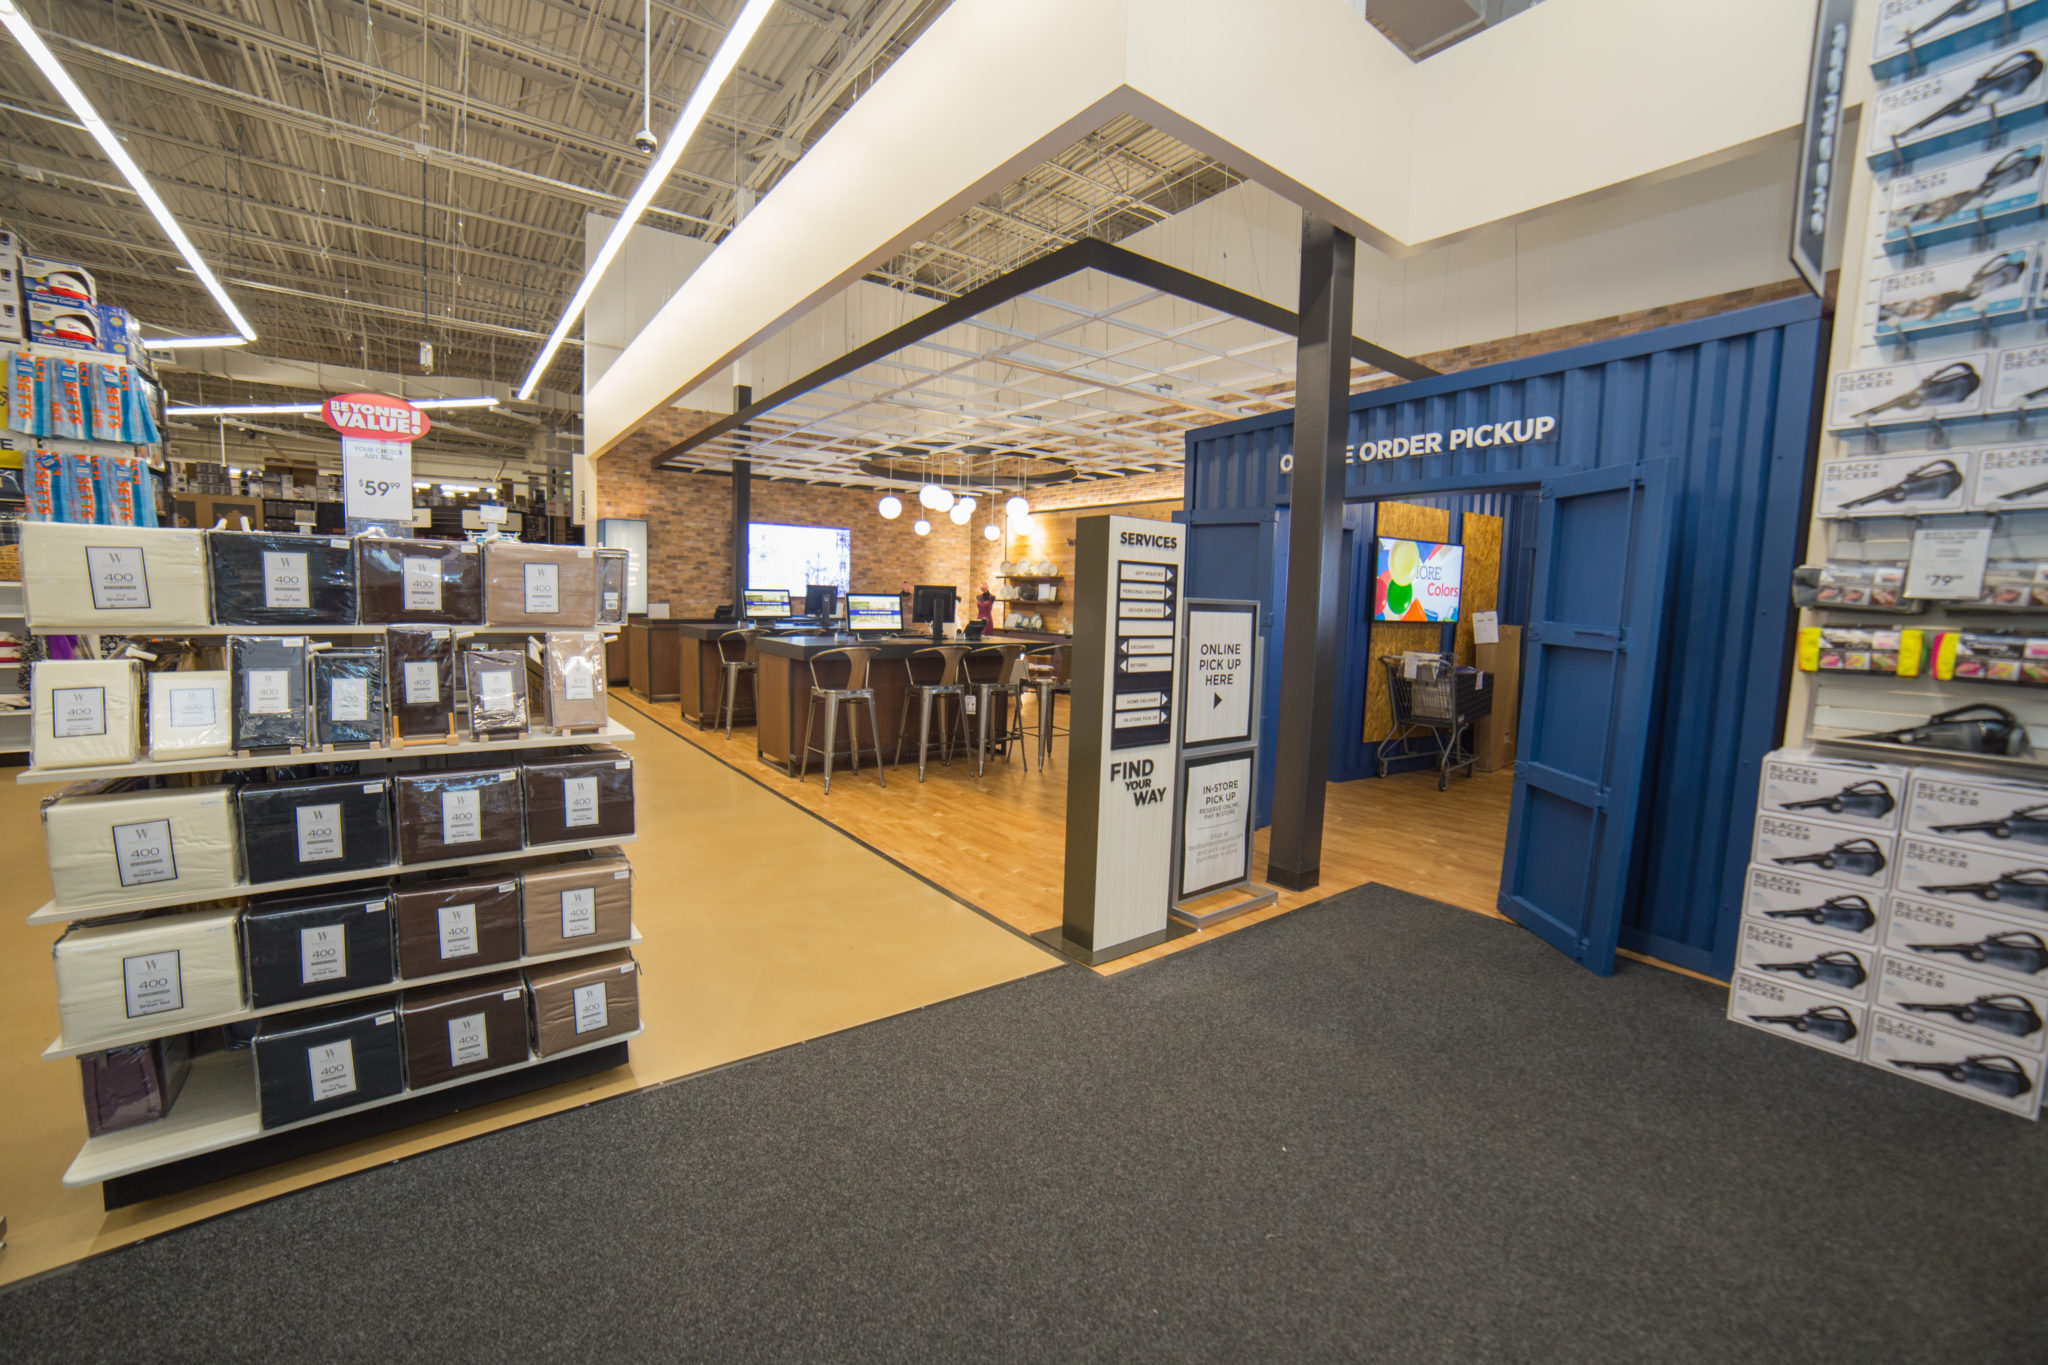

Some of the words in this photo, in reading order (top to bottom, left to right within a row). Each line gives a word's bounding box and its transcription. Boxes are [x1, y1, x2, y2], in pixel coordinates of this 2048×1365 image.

[1840, 372, 1892, 384] BLACK+
[1839, 379, 1892, 392] DECKER
[330, 400, 410, 418] BEYOND
[330, 410, 421, 435] VALUE!
[1358, 432, 1442, 462] ORDER
[1450, 416, 1556, 450] PICKUP
[1828, 464, 1879, 474] BLACK+
[1827, 472, 1878, 482] DECKER
[1120, 532, 1177, 548] SERVICES
[104, 573, 134, 582] 400
[412, 580, 433, 588] 400
[532, 584, 552, 592] 400
[1428, 582, 1458, 598] Colors
[1200, 644, 1241, 655] ONLINE
[1200, 659, 1224, 670] PICK
[1228, 658, 1241, 670] UP
[1206, 674, 1233, 686] HERE
[67, 708, 92, 716] 400
[1111, 758, 1154, 782] FIND
[1770, 764, 1818, 777] BLACK+
[1125, 778, 1152, 791] YOUR
[1769, 772, 1818, 786] DECKER
[1203, 780, 1239, 794] IN-STORE
[1918, 782, 1979, 797] BLACK+
[573, 798, 591, 806] 400
[1134, 786, 1166, 806] WAY
[1206, 795, 1223, 805] PICK
[1226, 792, 1236, 801] UP
[1917, 791, 1979, 807] DECKER
[452, 812, 472, 821] 400
[1200, 806, 1222, 814] RESERVE
[307, 828, 332, 837] 400
[1763, 820, 1810, 832] BLACK+
[1762, 826, 1810, 840] DECKER
[130, 847, 160, 858] 400
[1910, 842, 1968, 859] BLACK+
[1908, 851, 1968, 868] DECKER
[1755, 873, 1801, 887] BLACK+
[1754, 880, 1801, 895] DECKER
[1896, 902, 1954, 919] BLACK+
[1895, 910, 1954, 928] DECKER
[448, 926, 468, 936] 400
[1747, 925, 1792, 941] BLACK+
[1746, 932, 1793, 949] DECKER
[312, 949, 336, 958] 400
[1888, 960, 1944, 979] BLACK+
[139, 978, 168, 988] 400
[1886, 967, 1944, 988] DECKER
[1738, 983, 1785, 1001] DECKER
[1739, 977, 1785, 994] BLACK+
[582, 1003, 600, 1012] 400
[1878, 1017, 1935, 1037] BLACK+
[458, 1034, 479, 1044] 400
[1876, 1025, 1936, 1047] DECKER
[320, 1064, 344, 1075] 400
